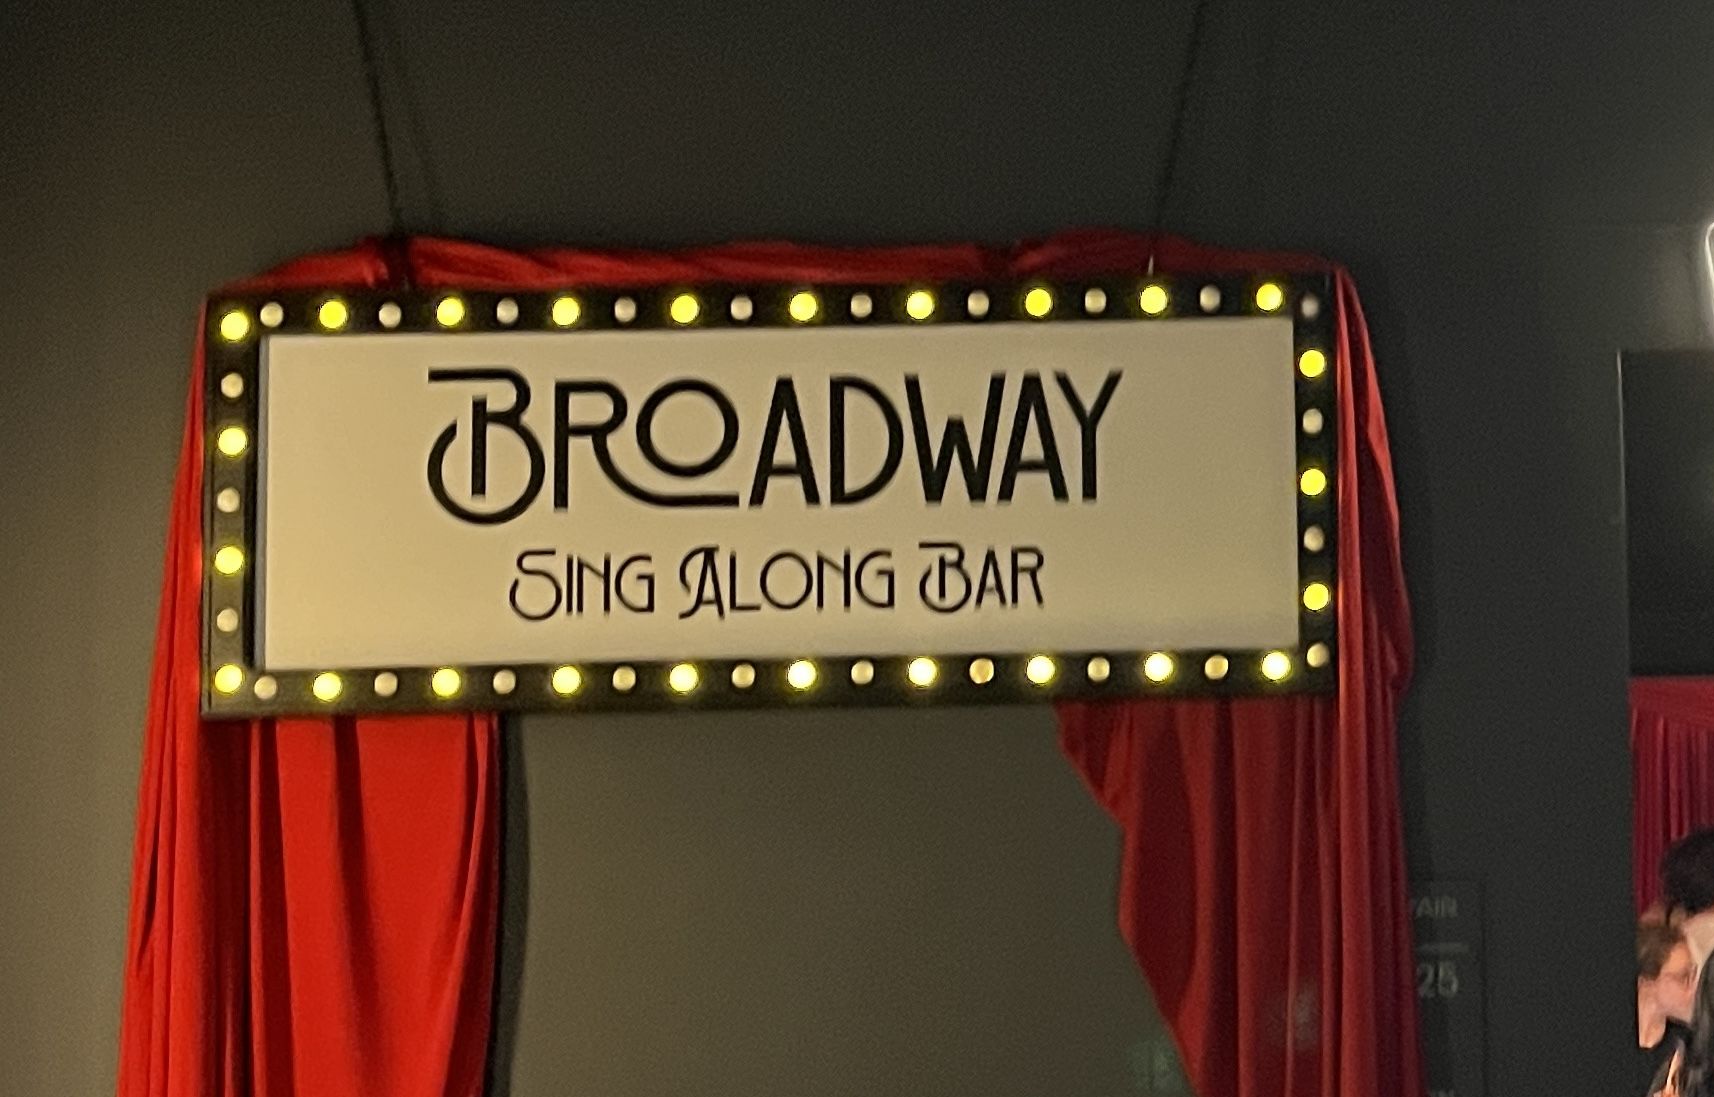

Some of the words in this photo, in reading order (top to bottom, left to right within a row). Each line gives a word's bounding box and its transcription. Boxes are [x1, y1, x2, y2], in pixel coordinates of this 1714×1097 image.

[427, 367, 1123, 525] BROADWAY
[509, 548, 655, 622] SING
[678, 543, 896, 621] ALONG
[918, 541, 1045, 614] BAR
[1410, 895, 1458, 919] AIR
